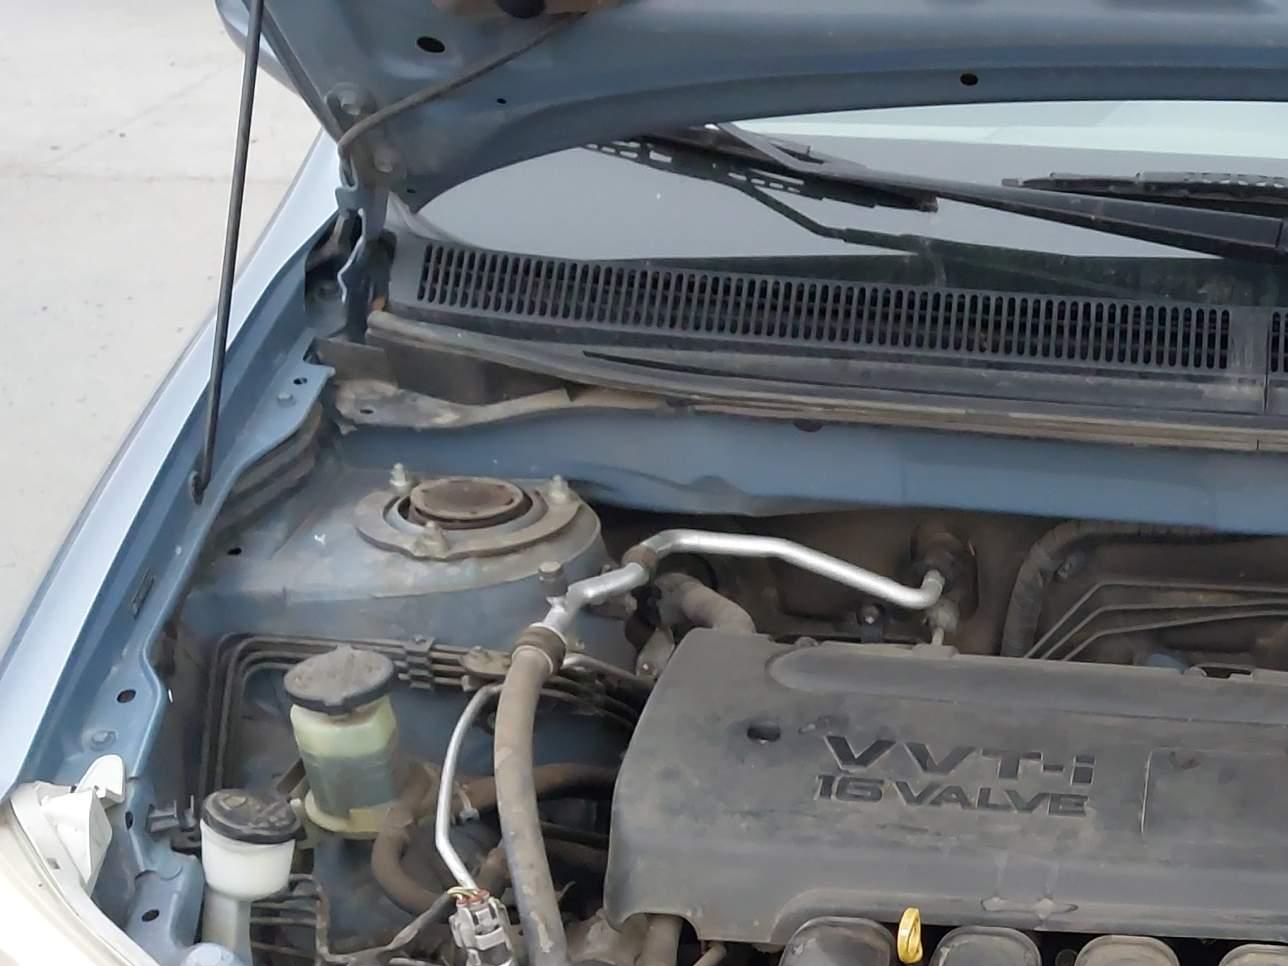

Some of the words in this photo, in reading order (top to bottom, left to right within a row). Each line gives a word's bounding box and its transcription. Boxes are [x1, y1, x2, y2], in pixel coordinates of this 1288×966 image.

[824, 735, 1096, 785] VVT-i
[815, 774, 884, 802] 16
[893, 780, 1089, 816] VALVE
